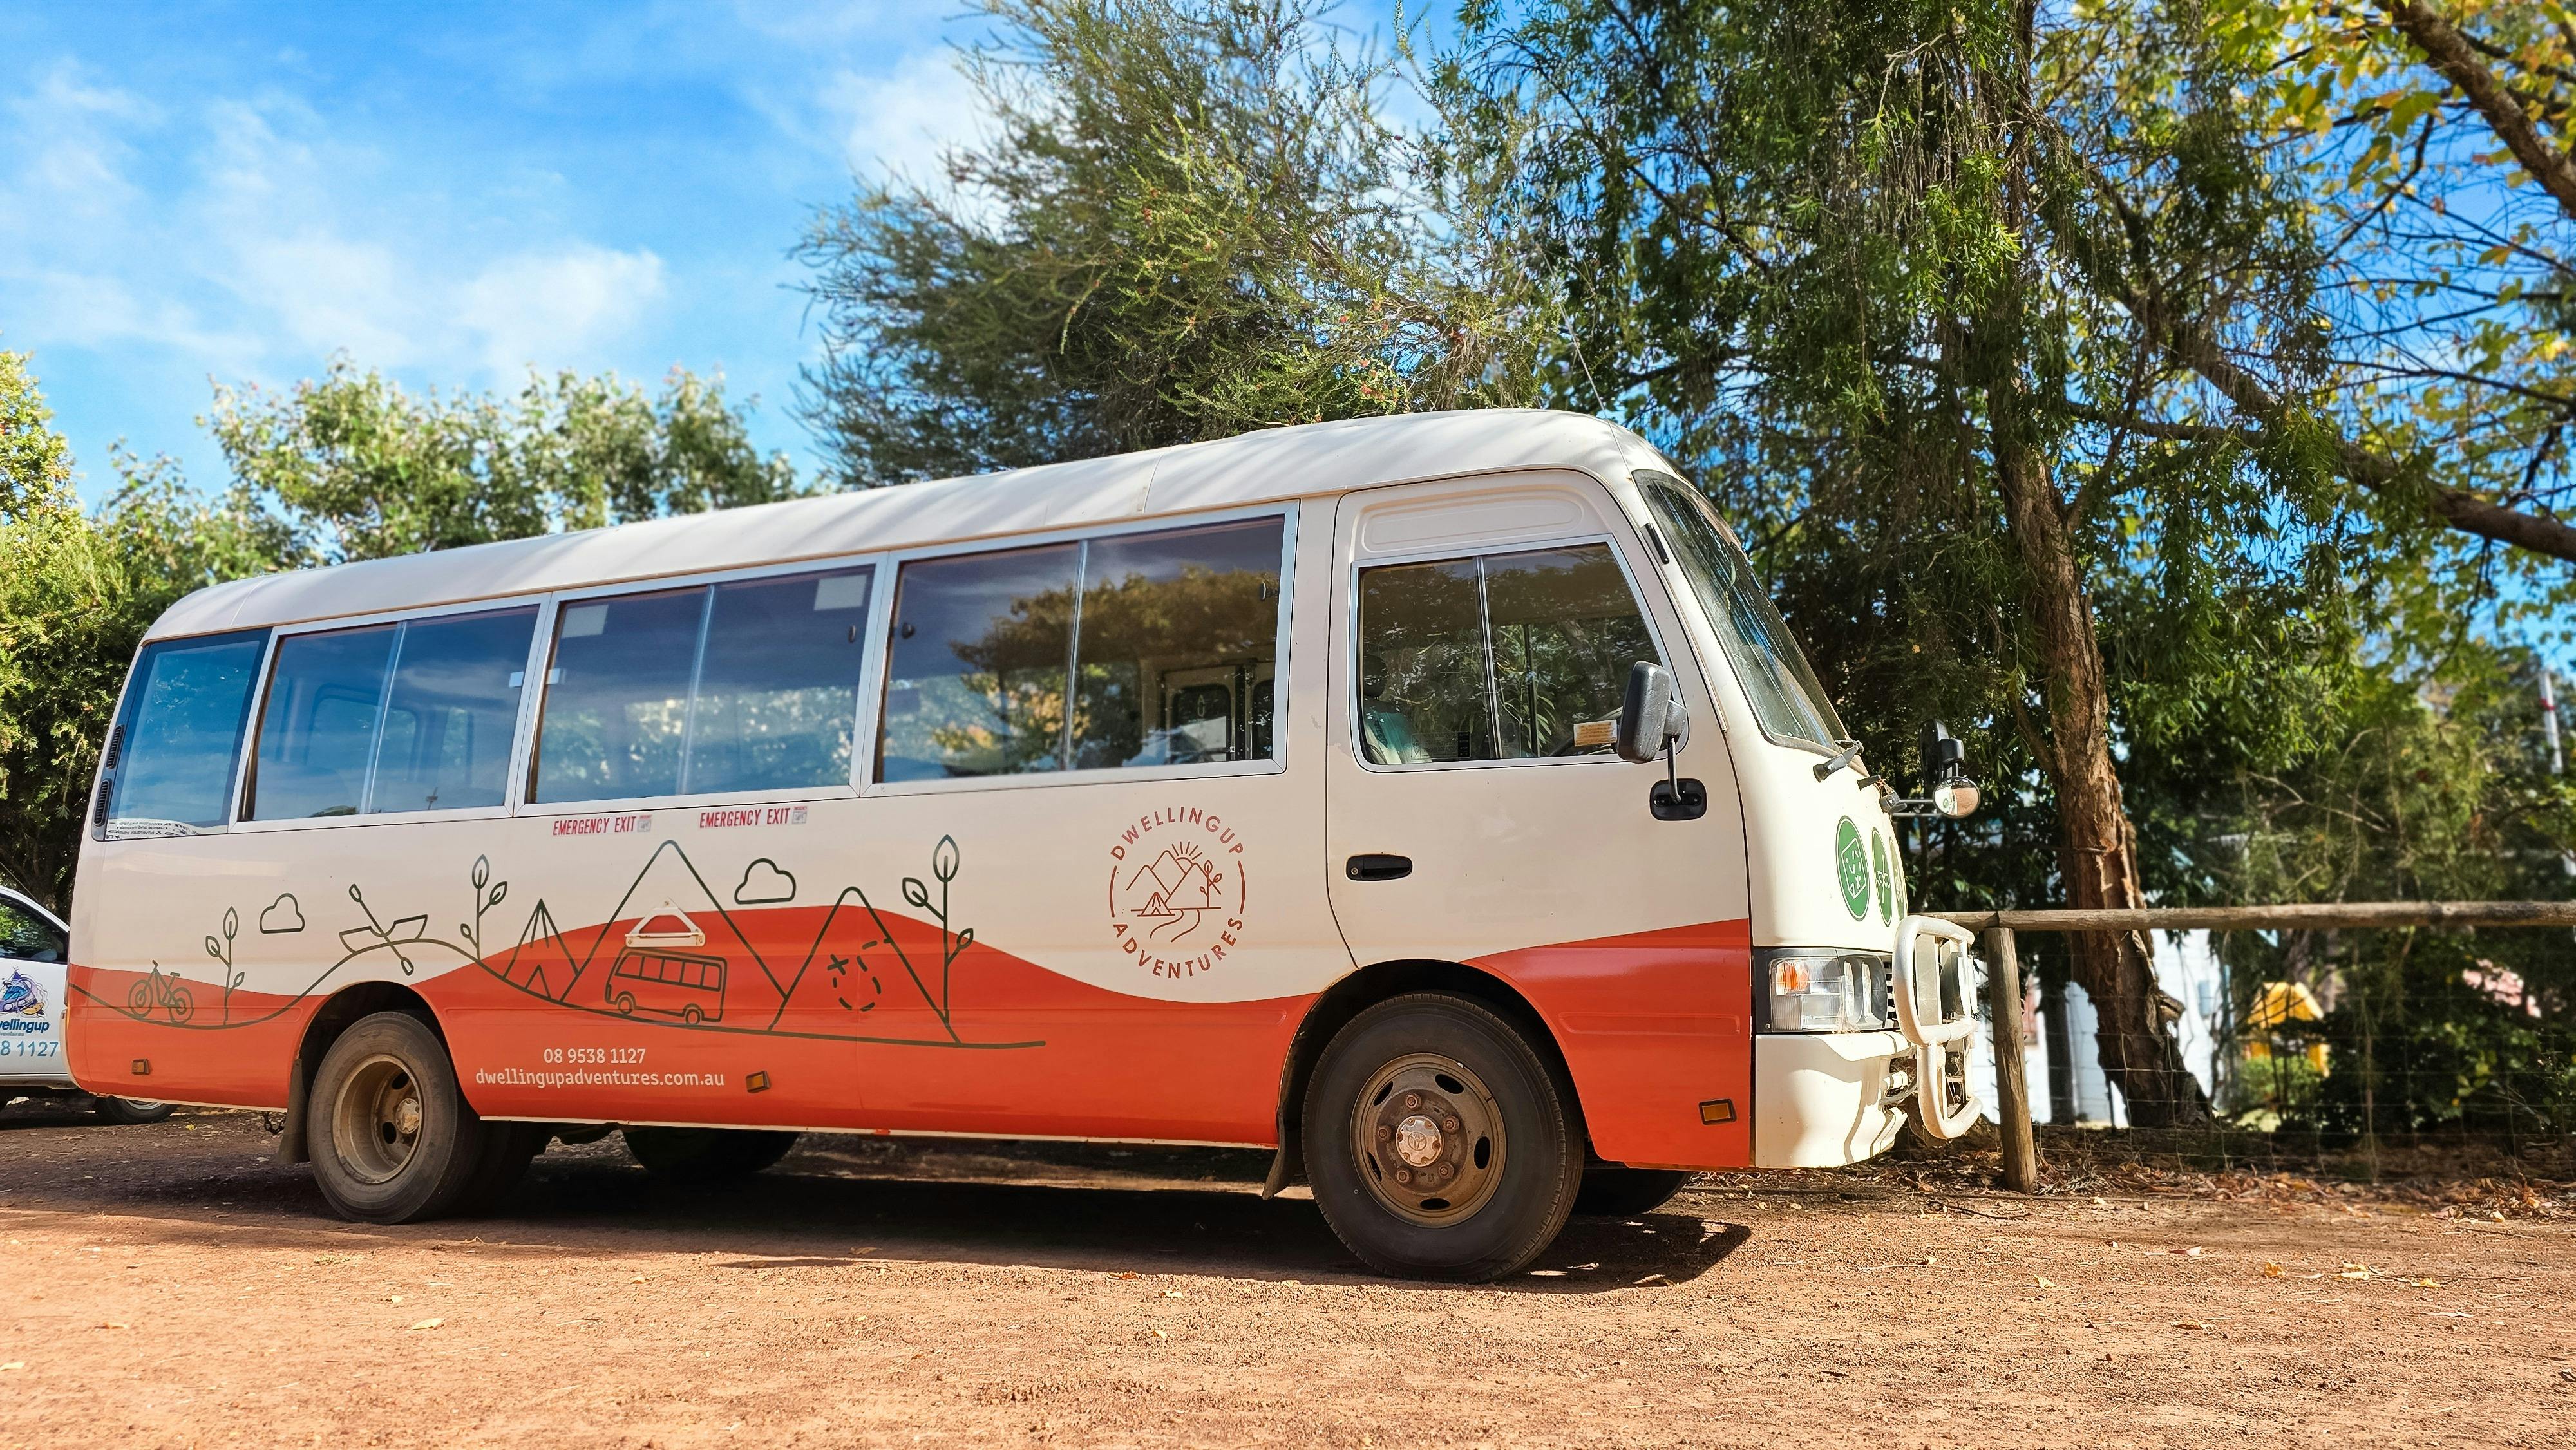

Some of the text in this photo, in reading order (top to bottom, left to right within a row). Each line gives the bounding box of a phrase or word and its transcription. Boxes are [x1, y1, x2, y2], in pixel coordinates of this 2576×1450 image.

[553, 817, 611, 836] EMERGENCY
[614, 816, 637, 833] EXIT
[700, 809, 762, 829] EMERGENCY
[766, 807, 791, 825] EXIT
[1111, 806, 1244, 861] DWELLINGUP
[1113, 917, 1243, 979] ADVENTURES
[0, 1019, 50, 1033] ellingup
[17, 1040, 59, 1057] 1127
[544, 1048, 646, 1064] 08 9538 1127
[476, 1068, 724, 1088] dwellingupadventures.com.au
